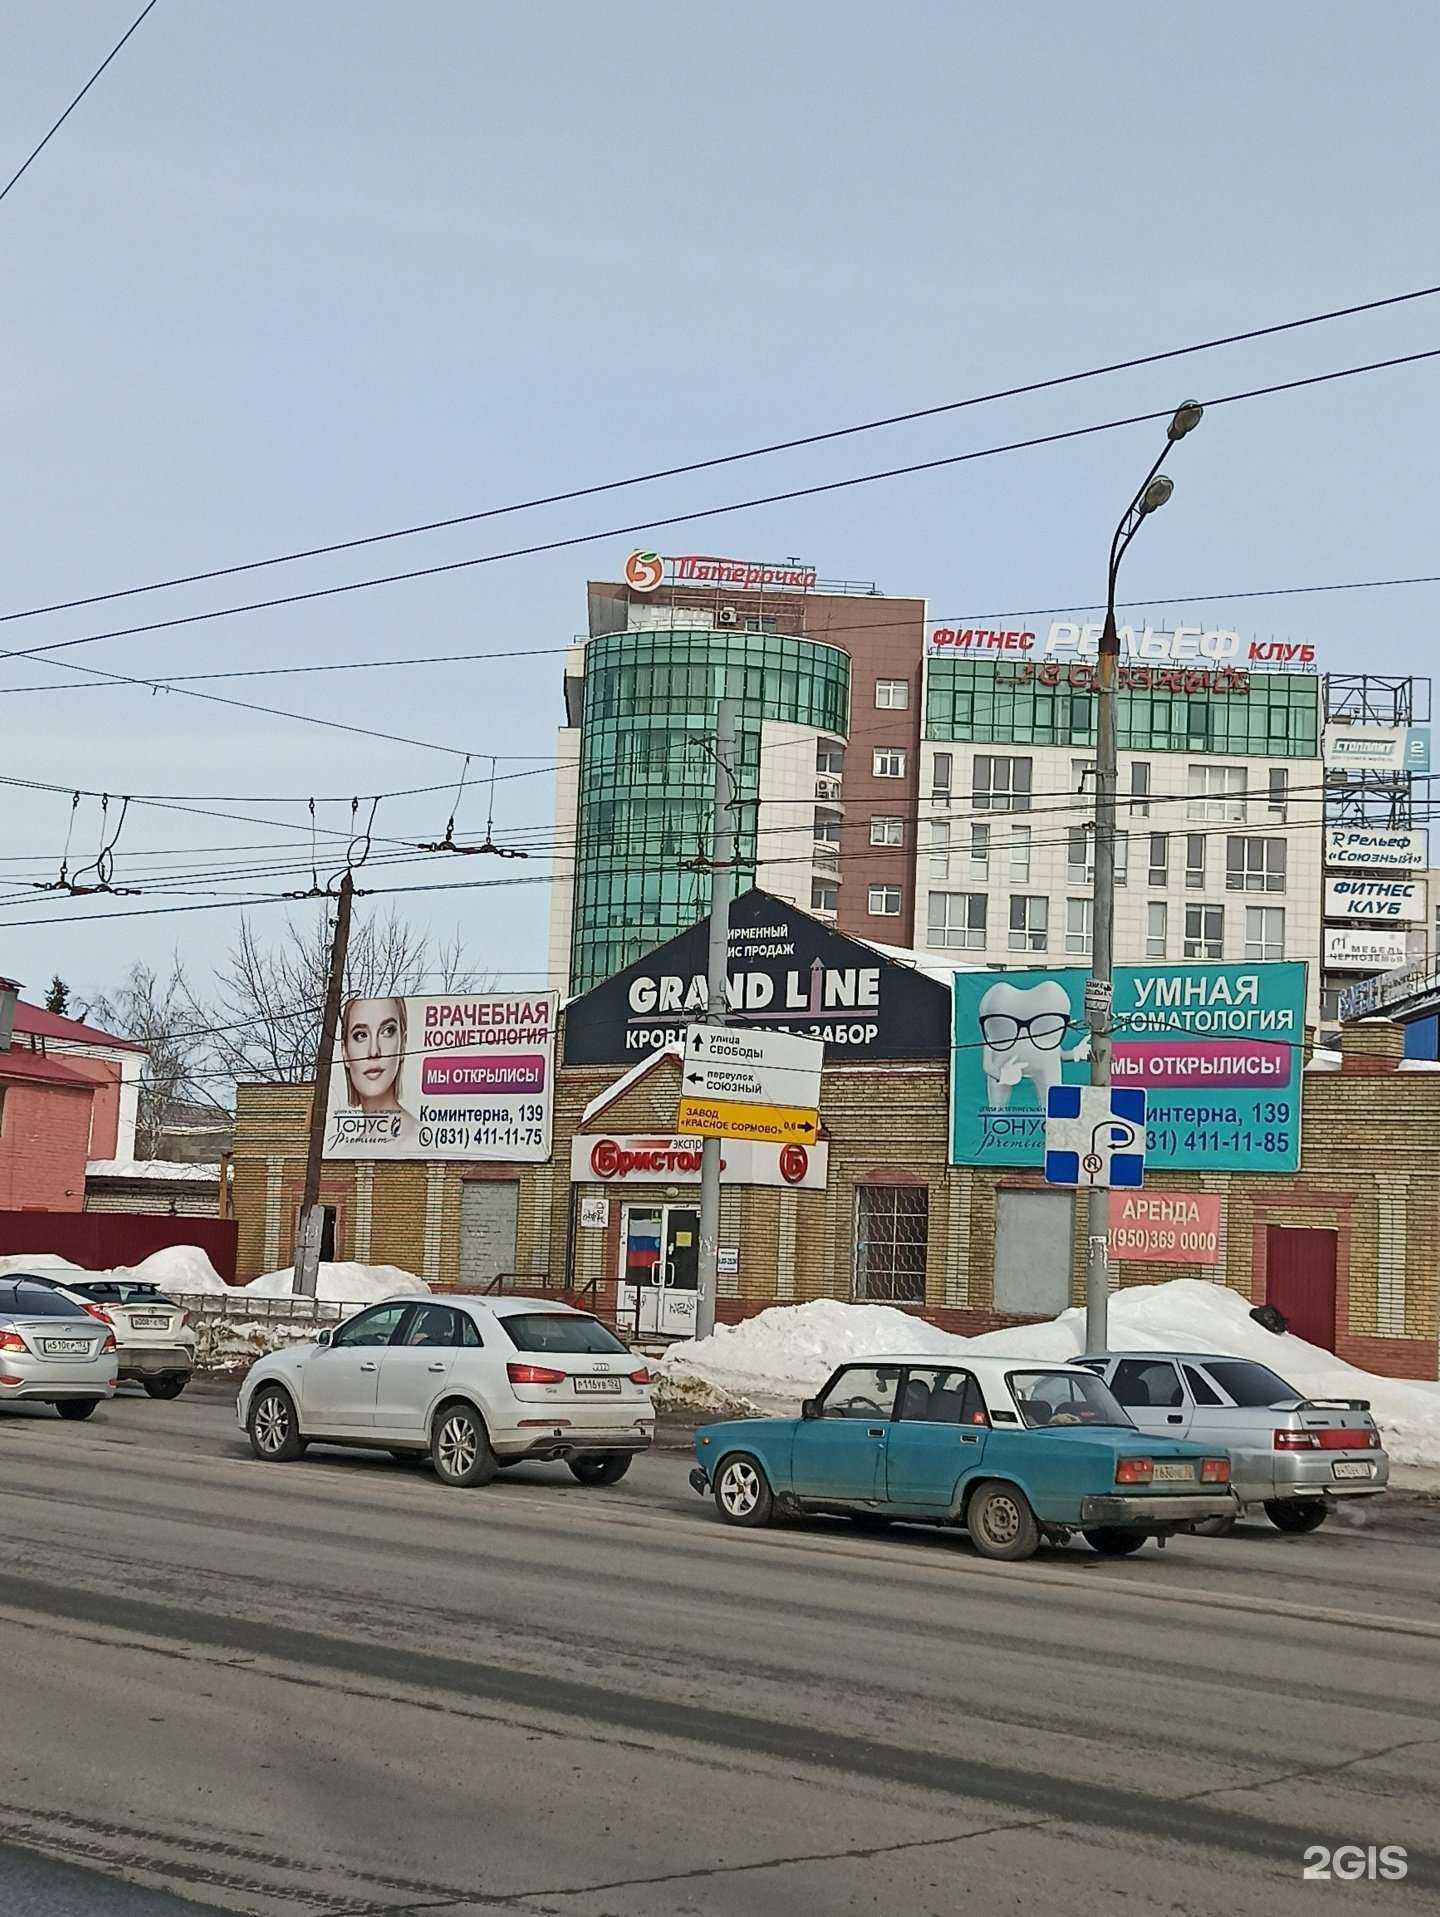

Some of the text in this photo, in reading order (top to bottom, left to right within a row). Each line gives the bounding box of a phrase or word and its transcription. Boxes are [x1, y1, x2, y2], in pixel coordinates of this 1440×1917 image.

[672, 555, 816, 589] Пятерочка
[933, 622, 1316, 663] ФИТНЕС РЕЛЬЕФ КЛУБ
[1333, 881, 1416, 897] ФИТНЕС
[1347, 900, 1403, 915] КЛУБ
[727, 923, 788, 940] ИРМЕННЫЙ
[727, 942, 796, 959] ИС ПРОДАЖ
[628, 960, 880, 1014] GRAND LINE
[1133, 975, 1259, 1008] УМНАЯ
[425, 1001, 549, 1028] ВРАЧЕБНАЯ
[1112, 1009, 1294, 1033] ТОМАТОЛОГИЯ
[424, 1028, 548, 1047] КОСМЕТОЛОГИЯ
[710, 1034, 741, 1046] улица
[709, 1045, 764, 1060] СВОБОДЫ
[427, 1067, 540, 1085] МЫ ОТКРЫЛИСЬ!
[1111, 1055, 1281, 1076] МЫ ОТКРЫЛИСЬ!
[706, 1081, 762, 1095] СОЮЗНЫЙ
[420, 1104, 544, 1126] Коминтерна, 139
[686, 1107, 719, 1120] ЗАВОД
[1146, 1102, 1290, 1127] интерна, 139
[435, 1128, 542, 1150] (831) 411-11-75
[1184, 1131, 1290, 1153] 411-11-85
[1122, 1199, 1200, 1226] АРЕНДА
[1180, 1231, 1217, 1251] 0000
